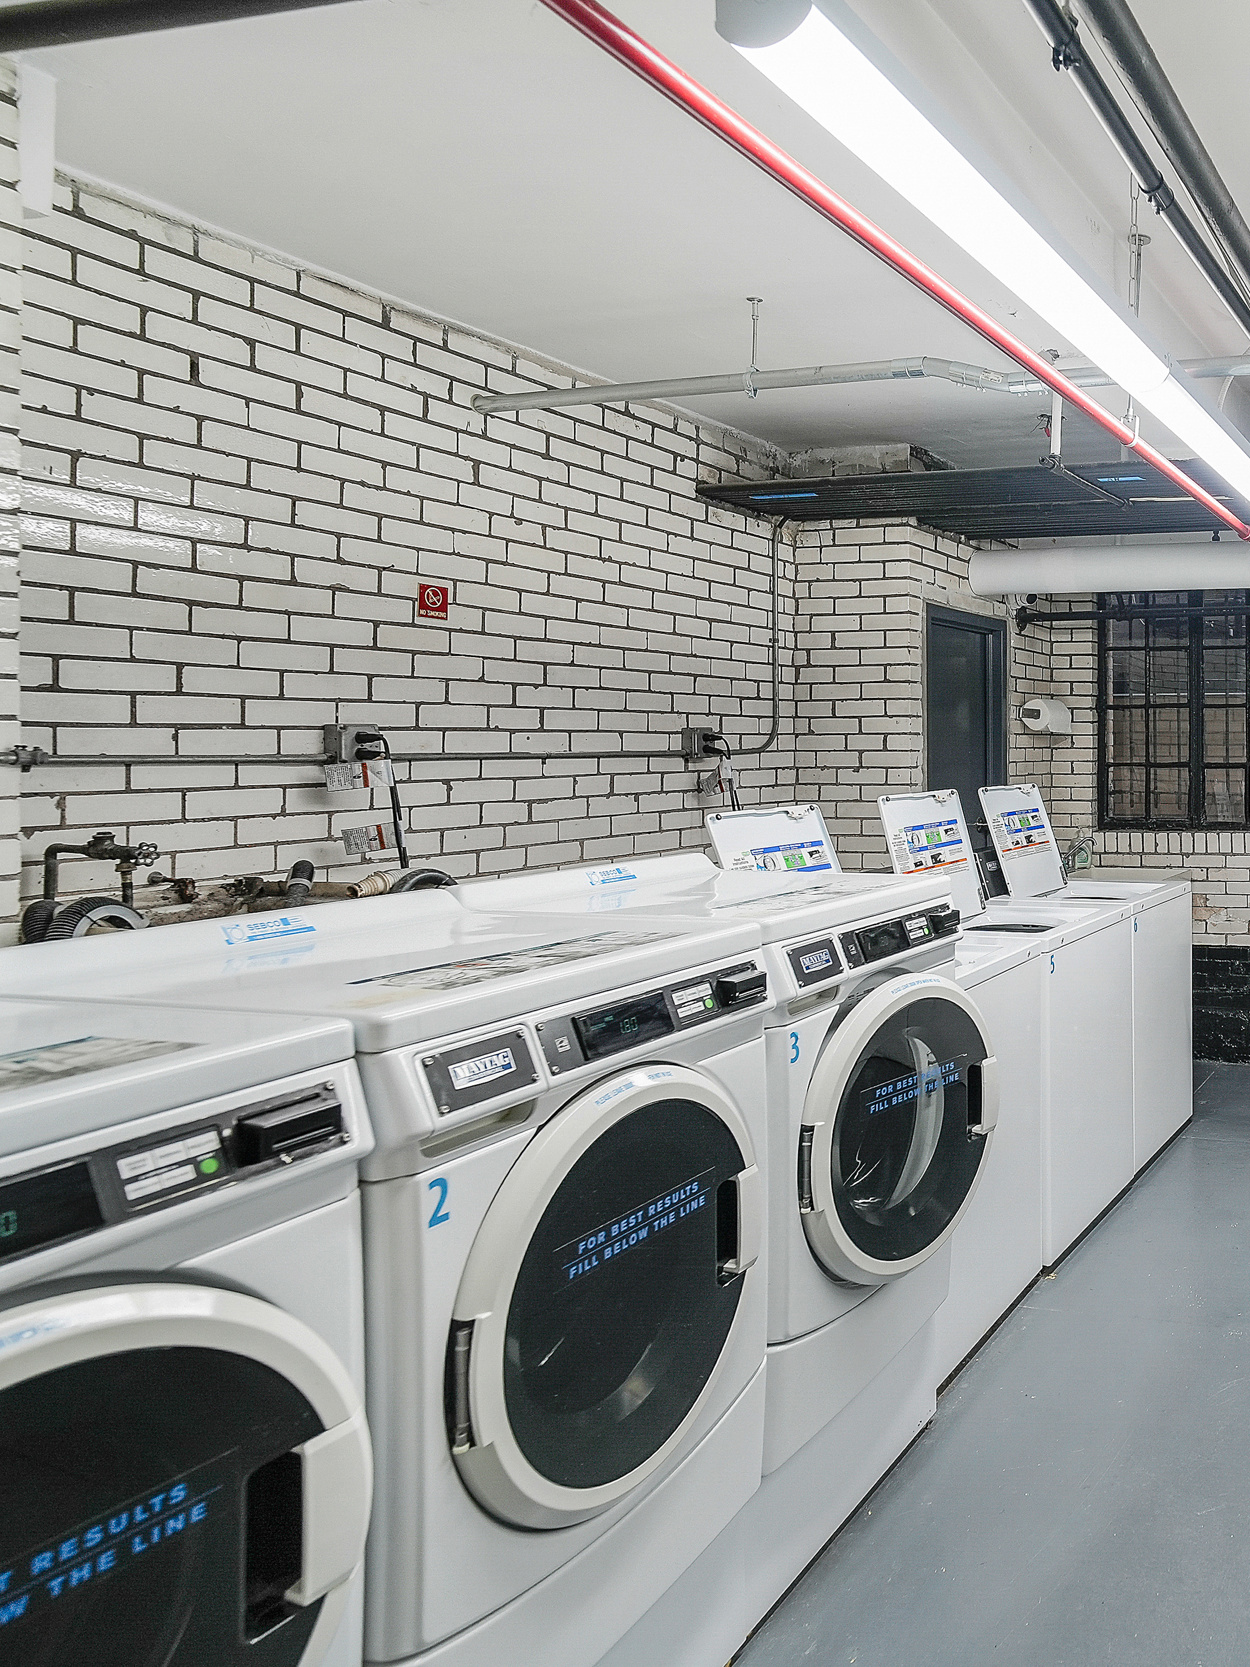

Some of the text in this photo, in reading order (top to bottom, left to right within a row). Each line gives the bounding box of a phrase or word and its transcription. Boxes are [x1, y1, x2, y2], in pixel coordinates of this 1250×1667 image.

[427, 609, 447, 618] SMOKING
[246, 920, 281, 931] SEBCO
[1133, 917, 1138, 933] 6
[802, 951, 829, 966] MAYTAG
[1050, 955, 1055, 974] 5
[790, 1031, 800, 1064] 3
[870, 1072, 960, 1115] FILL BELOW THE LINE
[875, 1084, 893, 1098] FOR
[896, 1076, 918, 1090] BEST
[428, 1177, 450, 1229] 2
[578, 1181, 699, 1255] FOR BEST RESULTS
[569, 1195, 706, 1280] FILL BELOW THE LINE
[30, 1482, 188, 1577] RESULTS
[48, 1549, 117, 1598] THE
[131, 1501, 208, 1554] LINE
